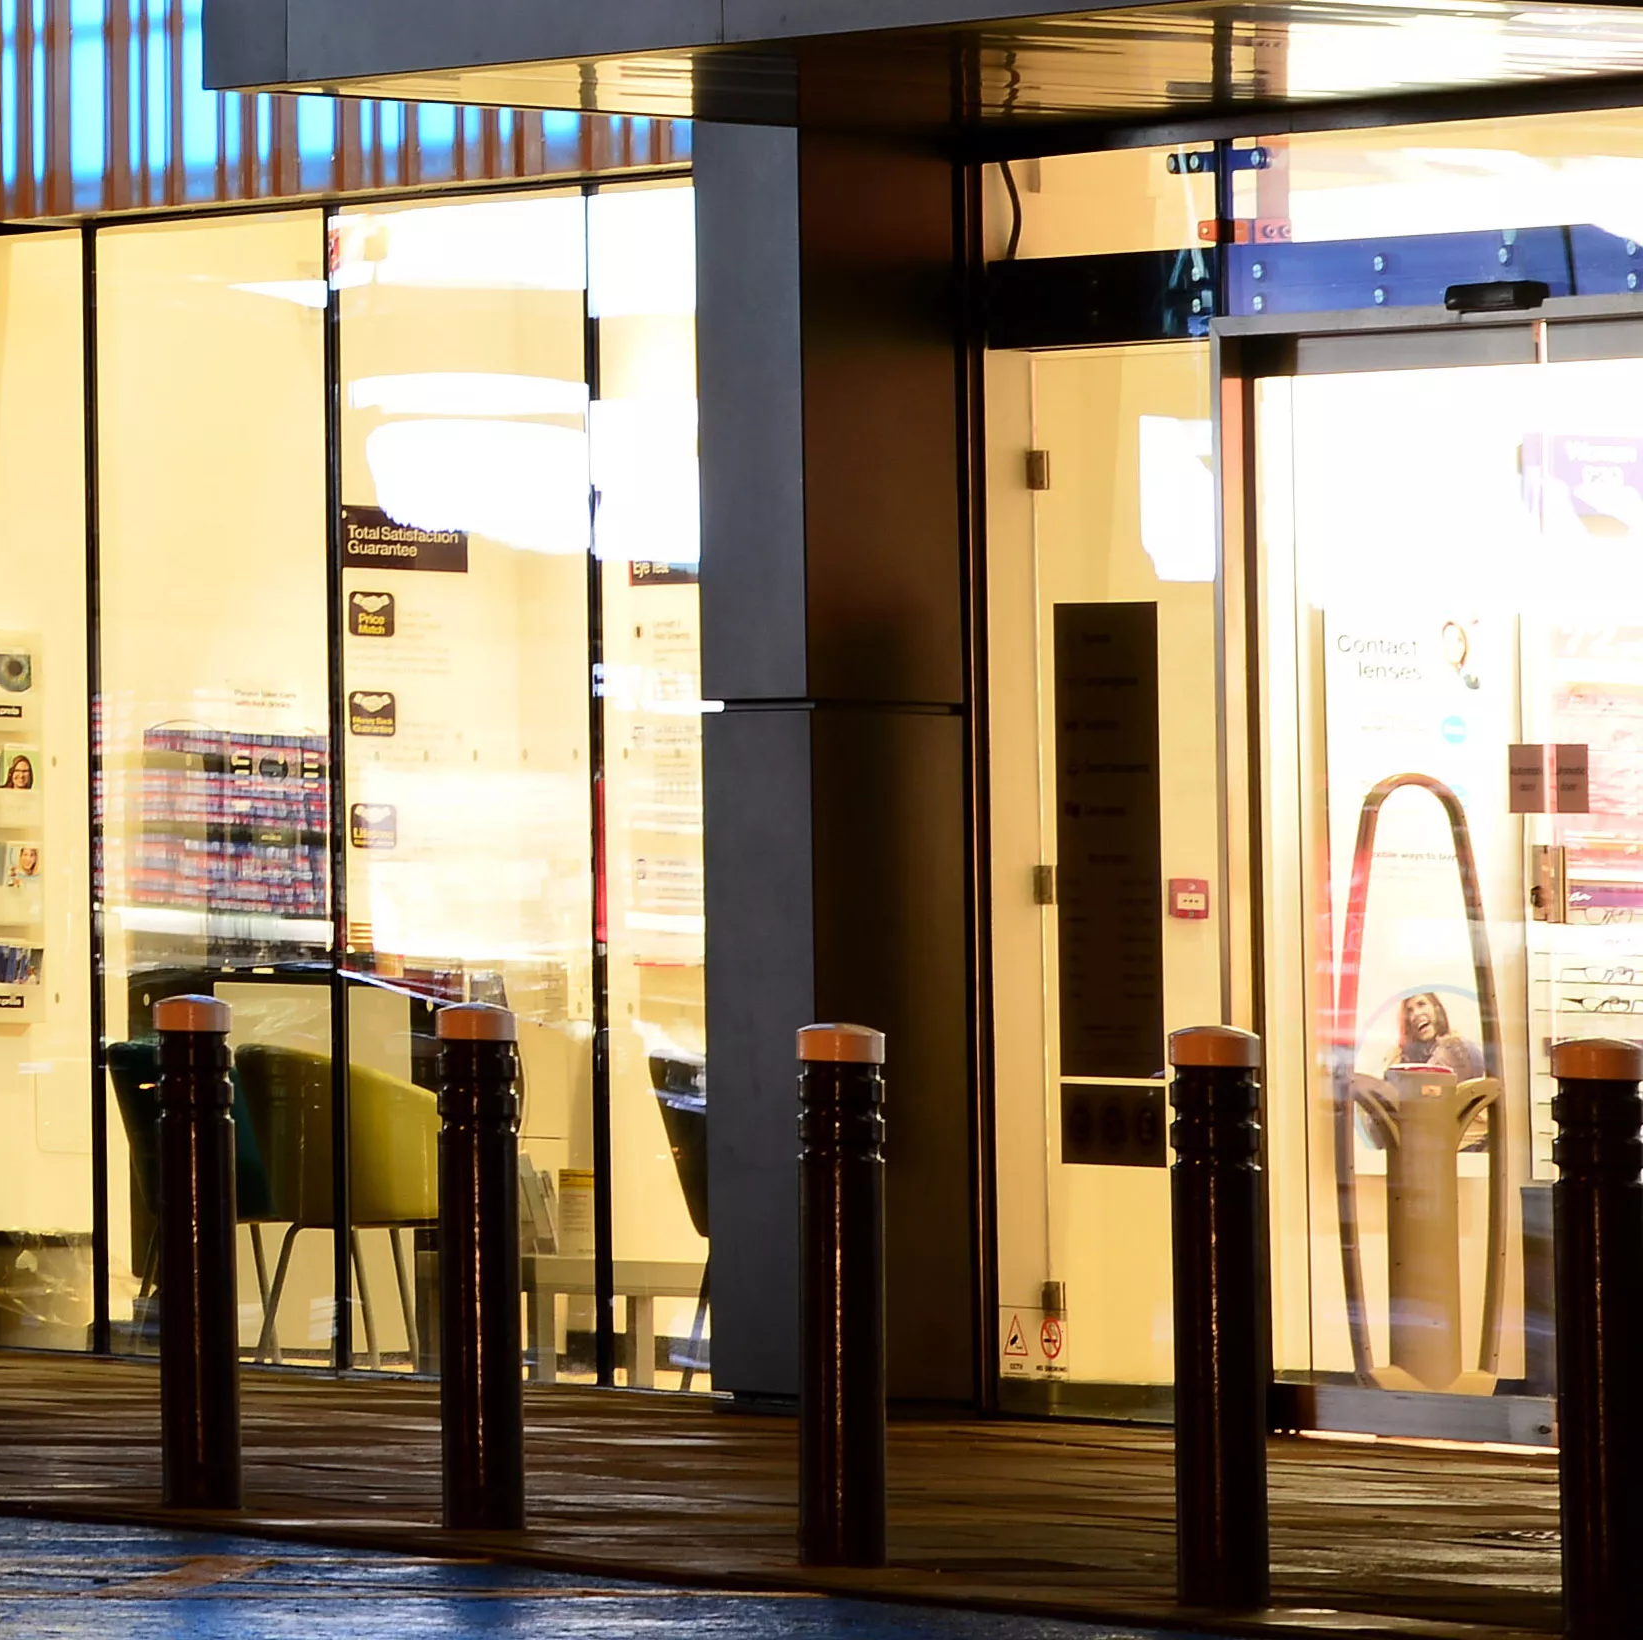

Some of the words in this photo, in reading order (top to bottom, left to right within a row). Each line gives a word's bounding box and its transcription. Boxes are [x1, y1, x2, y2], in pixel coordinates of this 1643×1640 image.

[348, 525, 380, 540] Total
[347, 540, 417, 558] Guarantee
[358, 612, 386, 625] Price
